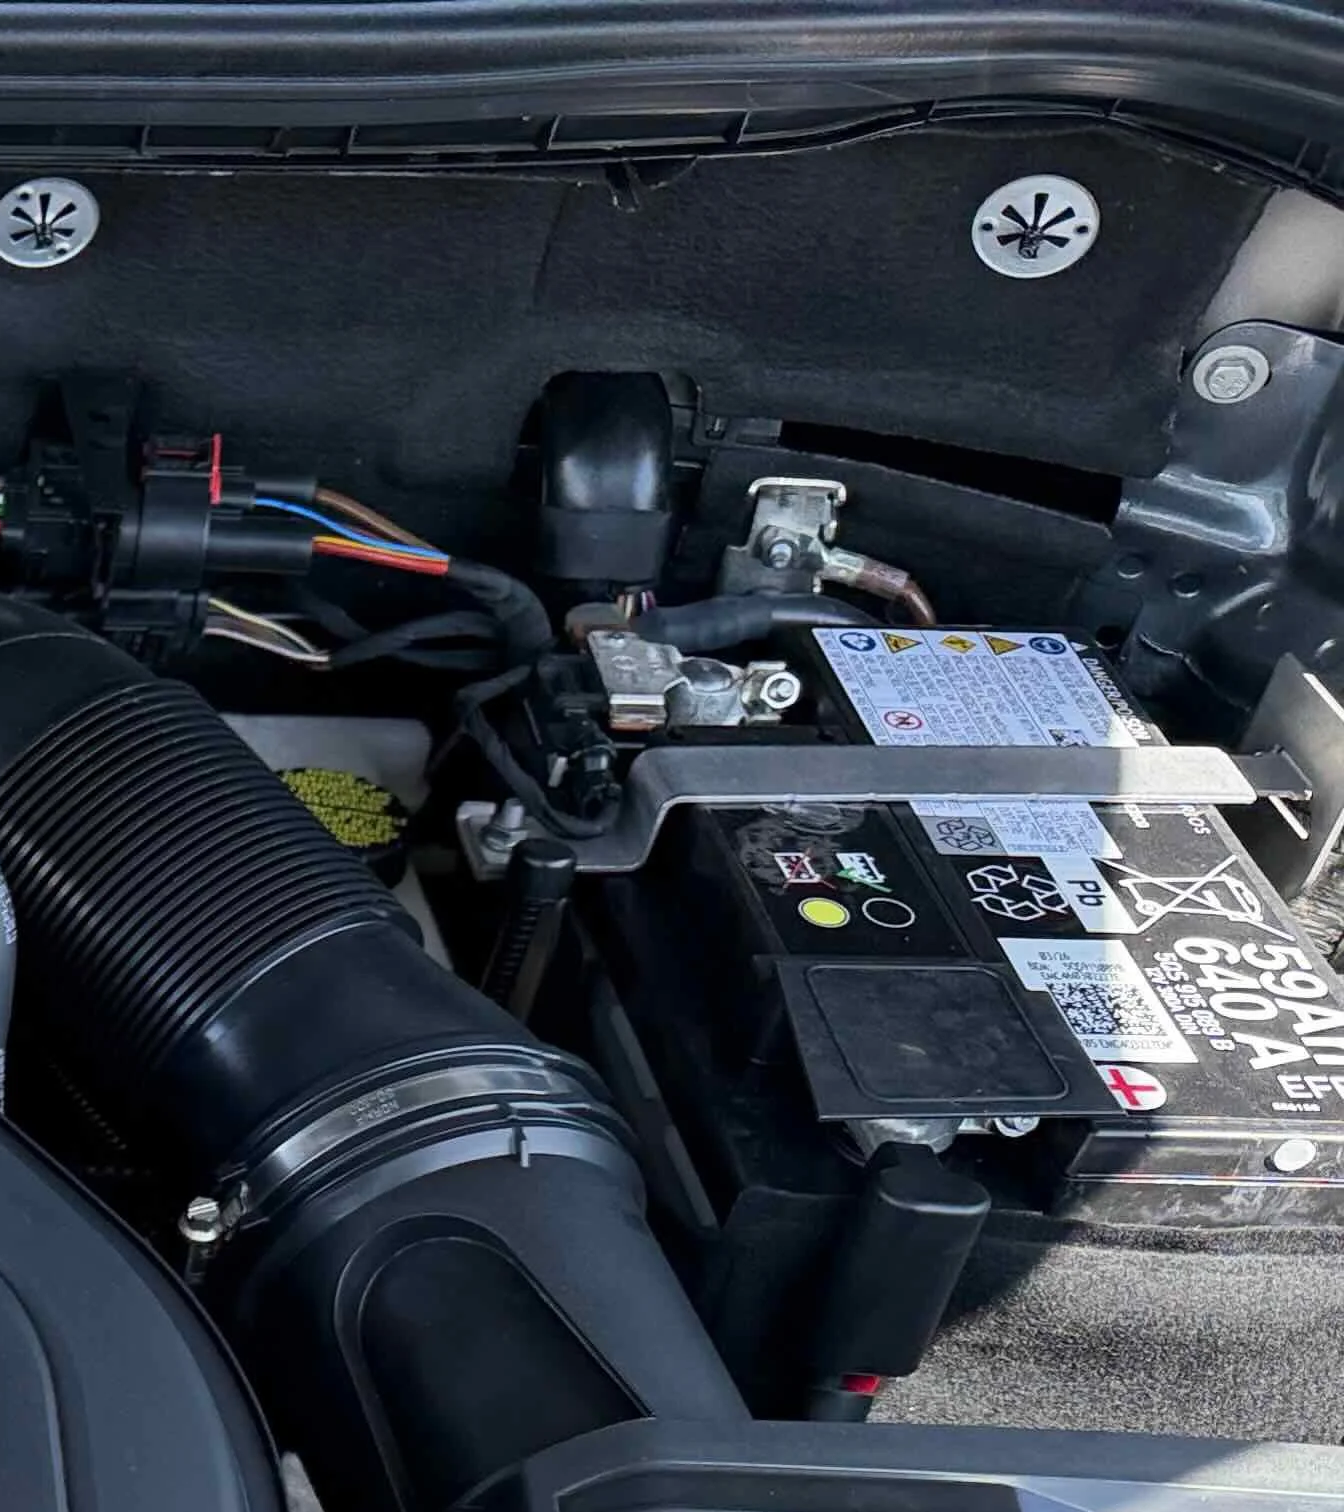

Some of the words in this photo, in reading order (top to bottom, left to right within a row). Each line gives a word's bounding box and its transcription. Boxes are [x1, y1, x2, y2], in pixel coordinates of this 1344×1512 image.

[1067, 879, 1106, 908] Pb
[1173, 937, 1262, 1021] 640
[1231, 1031, 1312, 1070] A
[1209, 1039, 1236, 1052] B
